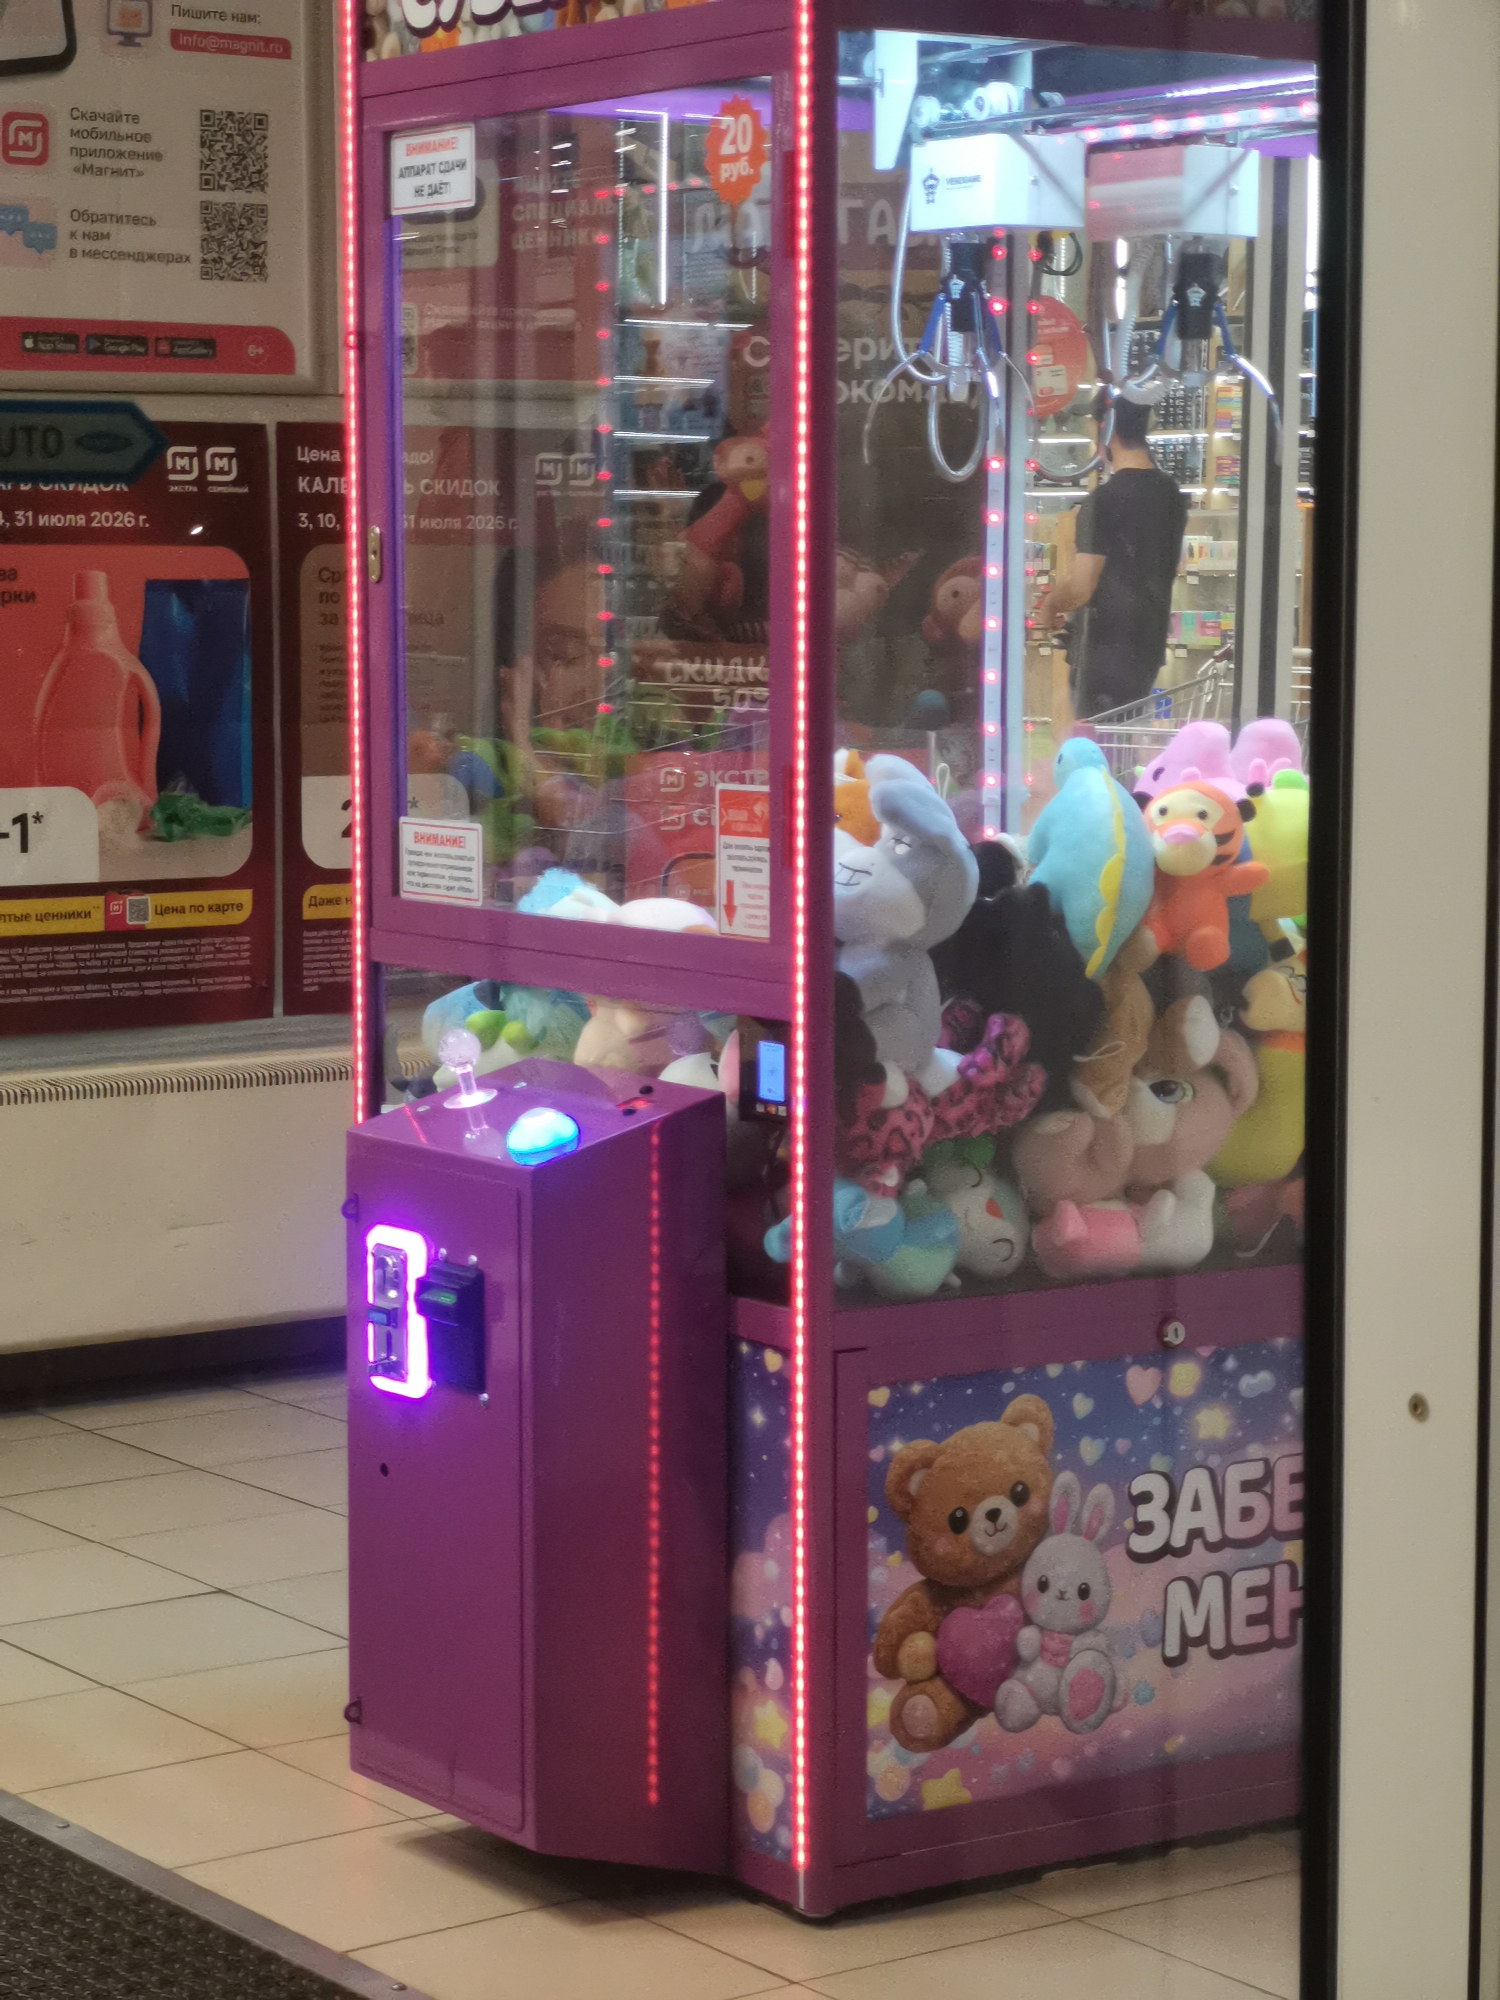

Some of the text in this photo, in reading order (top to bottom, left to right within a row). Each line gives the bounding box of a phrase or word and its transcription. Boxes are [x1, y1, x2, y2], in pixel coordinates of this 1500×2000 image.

[171, 3, 228, 21] Пишите
[69, 106, 140, 124] Скачайте
[69, 126, 152, 143] мобильное
[719, 113, 753, 155] 20
[69, 146, 164, 162] приложение
[72, 163, 145, 177] «Магнит»
[398, 158, 467, 179] АППАРАТ СДАЧИ
[719, 155, 755, 183] руб.
[70, 208, 157, 227] Обратитесь
[82, 230, 111, 242] нам
[82, 249, 192, 266] мессенджерах
[297, 445, 341, 464] Цена
[419, 478, 500, 498] СКИДОК
[14, 510, 34, 527] 31
[38, 513, 86, 527] июля
[90, 511, 135, 528] 2026
[317, 512, 341, 531] 10,
[154, 903, 187, 917] Цена
[188, 902, 206, 914] по
[207, 900, 244, 914] карте
[308, 895, 342, 909] Даже
